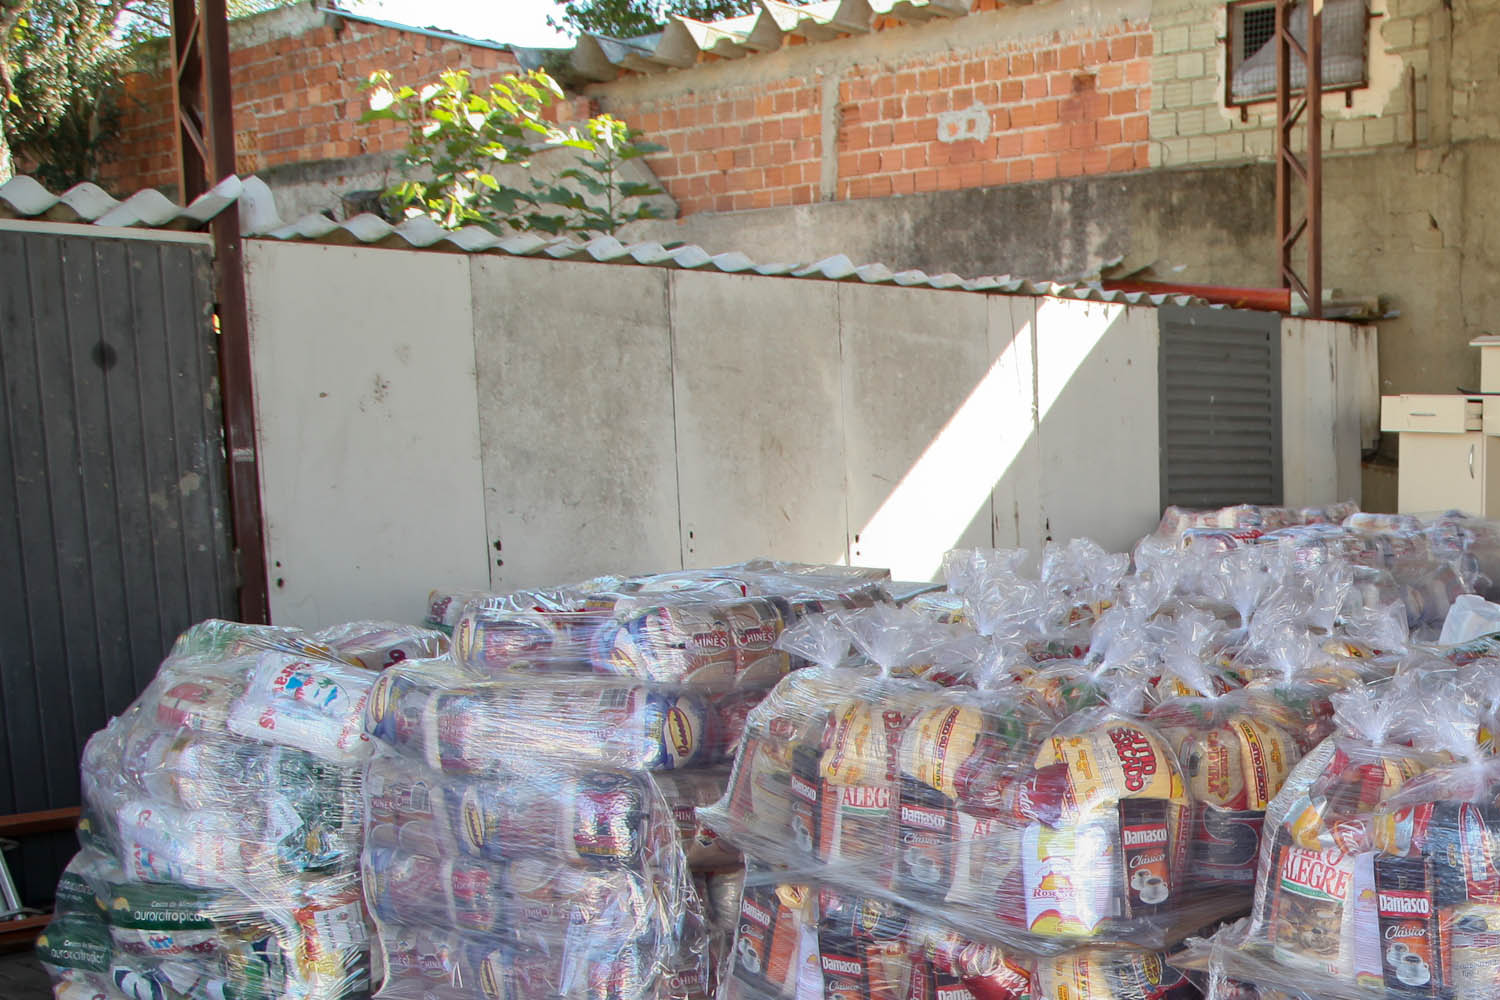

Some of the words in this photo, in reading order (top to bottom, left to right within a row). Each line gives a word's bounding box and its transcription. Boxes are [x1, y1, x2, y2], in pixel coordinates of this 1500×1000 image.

[901, 806, 946, 828] Damasco
[1123, 826, 1168, 847] Damasco
[1282, 855, 1352, 898] ALEGRE
[1379, 894, 1430, 915] Damasco
[134, 909, 209, 925] auroratropica
[1384, 923, 1427, 940] Clássico
[822, 955, 862, 976] Damasco
